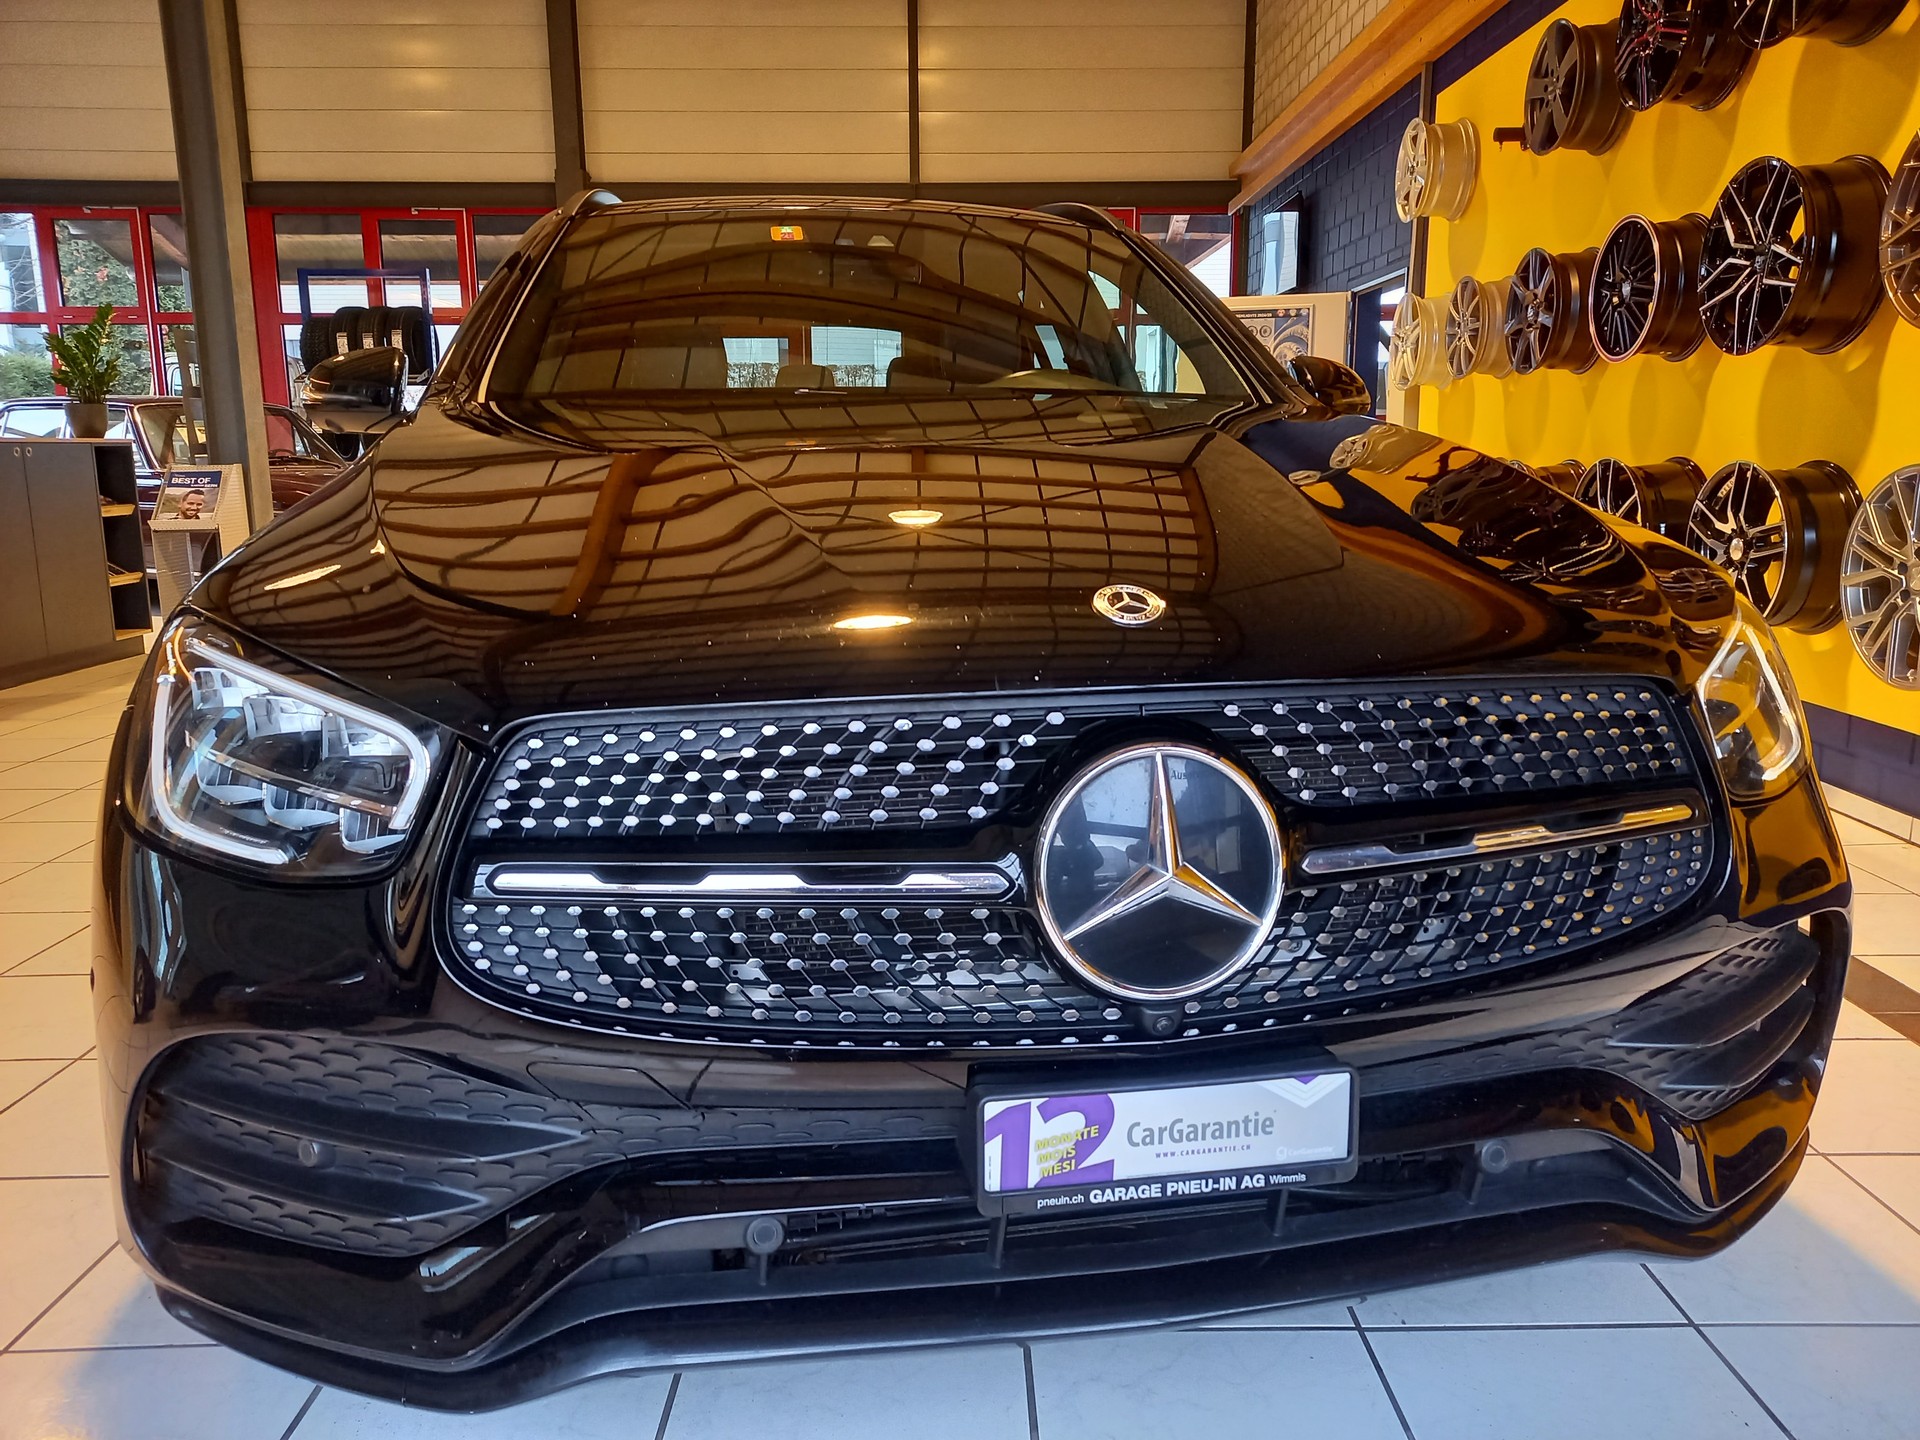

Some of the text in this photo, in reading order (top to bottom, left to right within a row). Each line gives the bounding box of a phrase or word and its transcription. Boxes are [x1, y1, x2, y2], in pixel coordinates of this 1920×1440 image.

[1035, 1125, 1099, 1150] MONATE
[1127, 1111, 1274, 1147] CarGarantie
[1038, 1146, 1076, 1164] MOIS
[1039, 1159, 1076, 1178] MESI
[1089, 1182, 1162, 1204] GARAGE
[1166, 1176, 1237, 1197] PNEU-IN
[1240, 1173, 1266, 1189] AG
[1269, 1172, 1307, 1185] Wimmis
